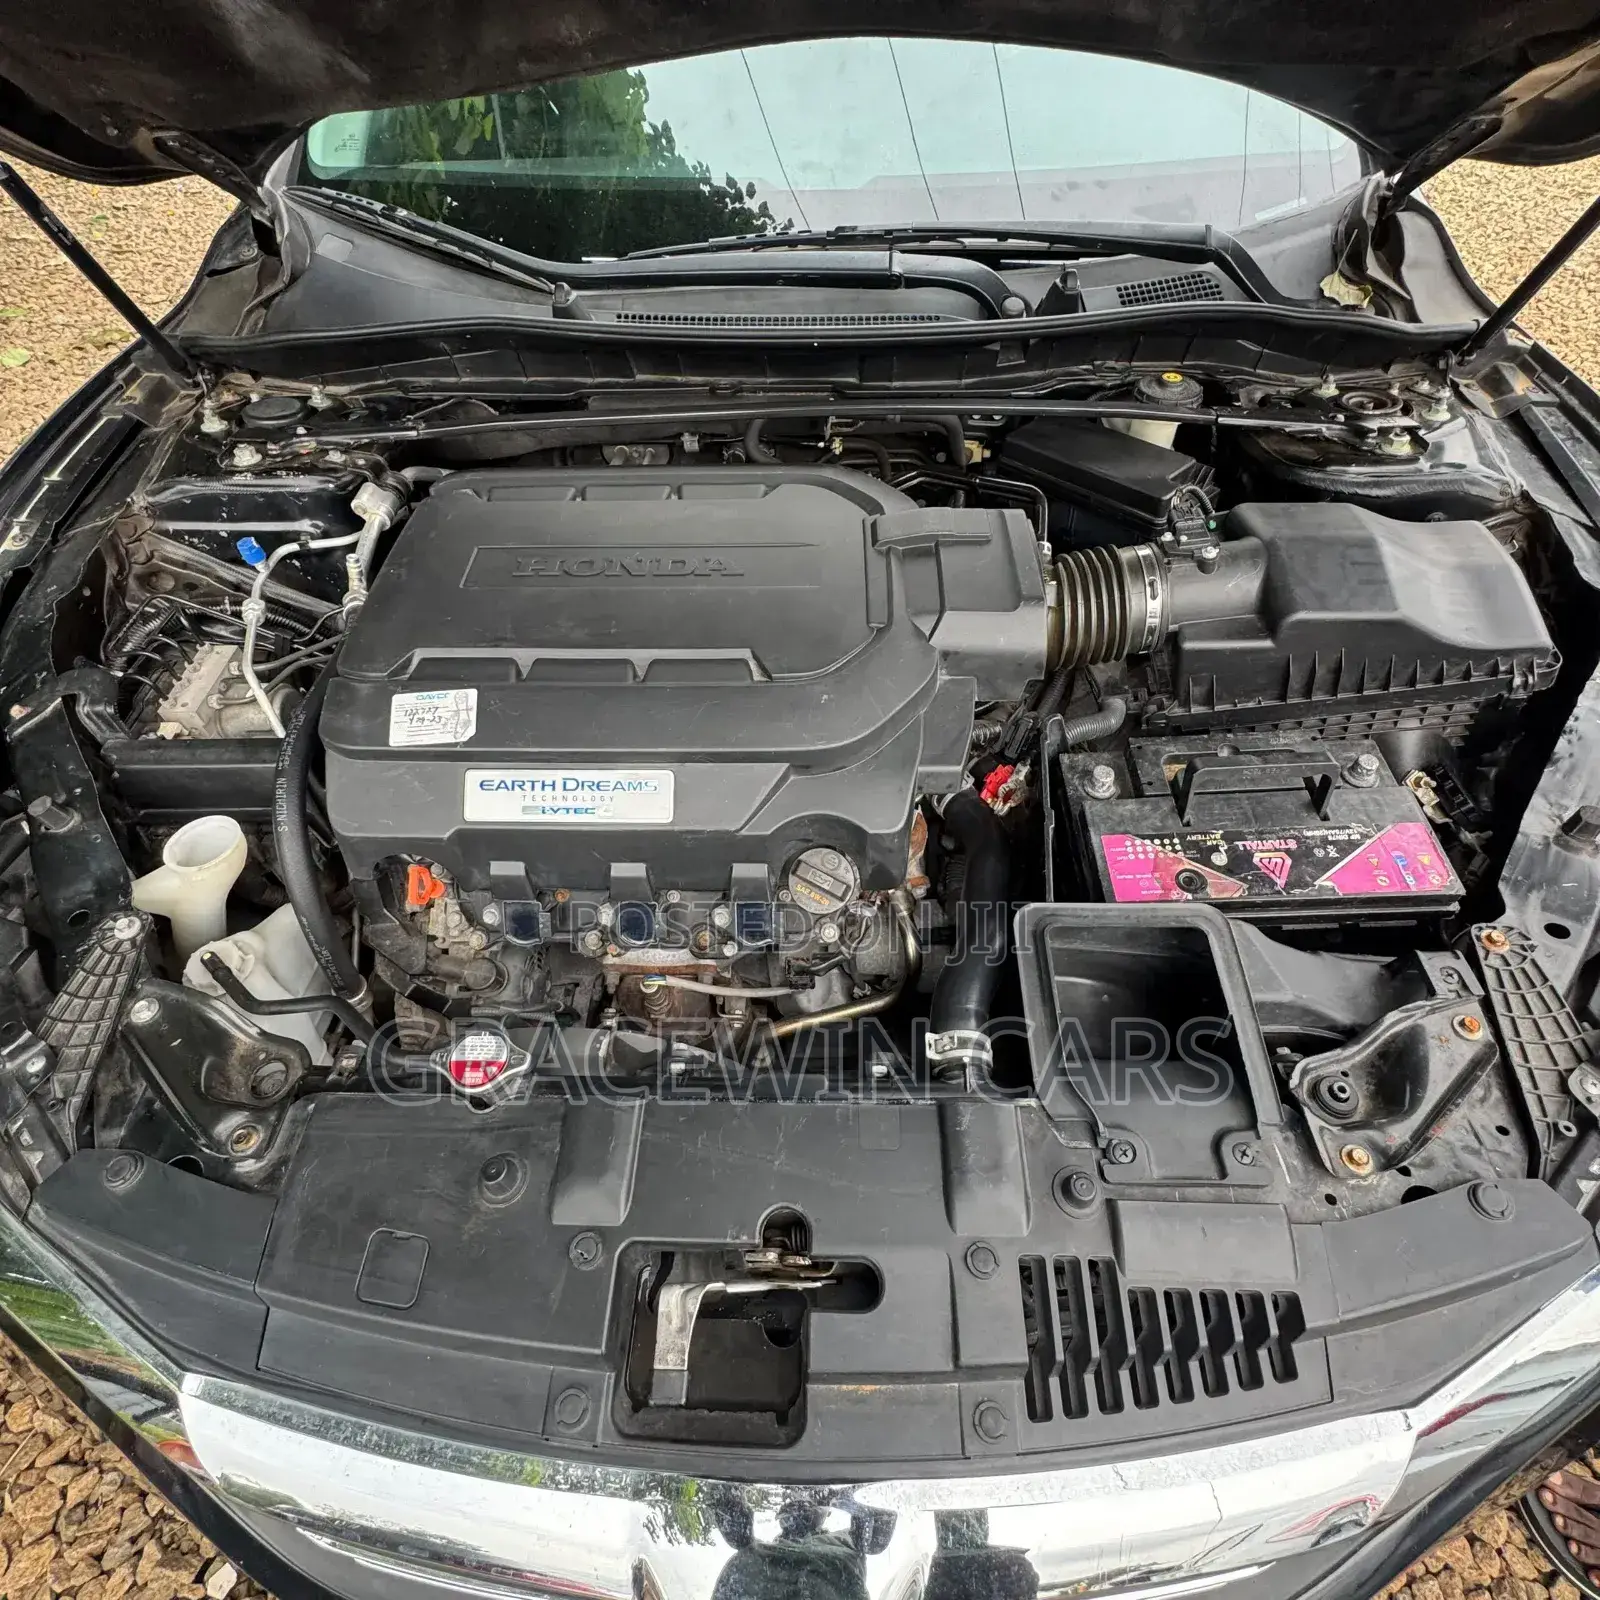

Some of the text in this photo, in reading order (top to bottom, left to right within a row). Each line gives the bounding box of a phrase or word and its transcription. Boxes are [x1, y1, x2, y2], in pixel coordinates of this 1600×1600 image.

[511, 555, 745, 578] HONDA
[479, 777, 659, 792] EARTH DREAMS
[522, 794, 615, 802] TECHNOLOGY
[1186, 832, 1222, 841] BATTERY
[1233, 839, 1298, 850] STARTALL
[795, 883, 811, 896] SAE
